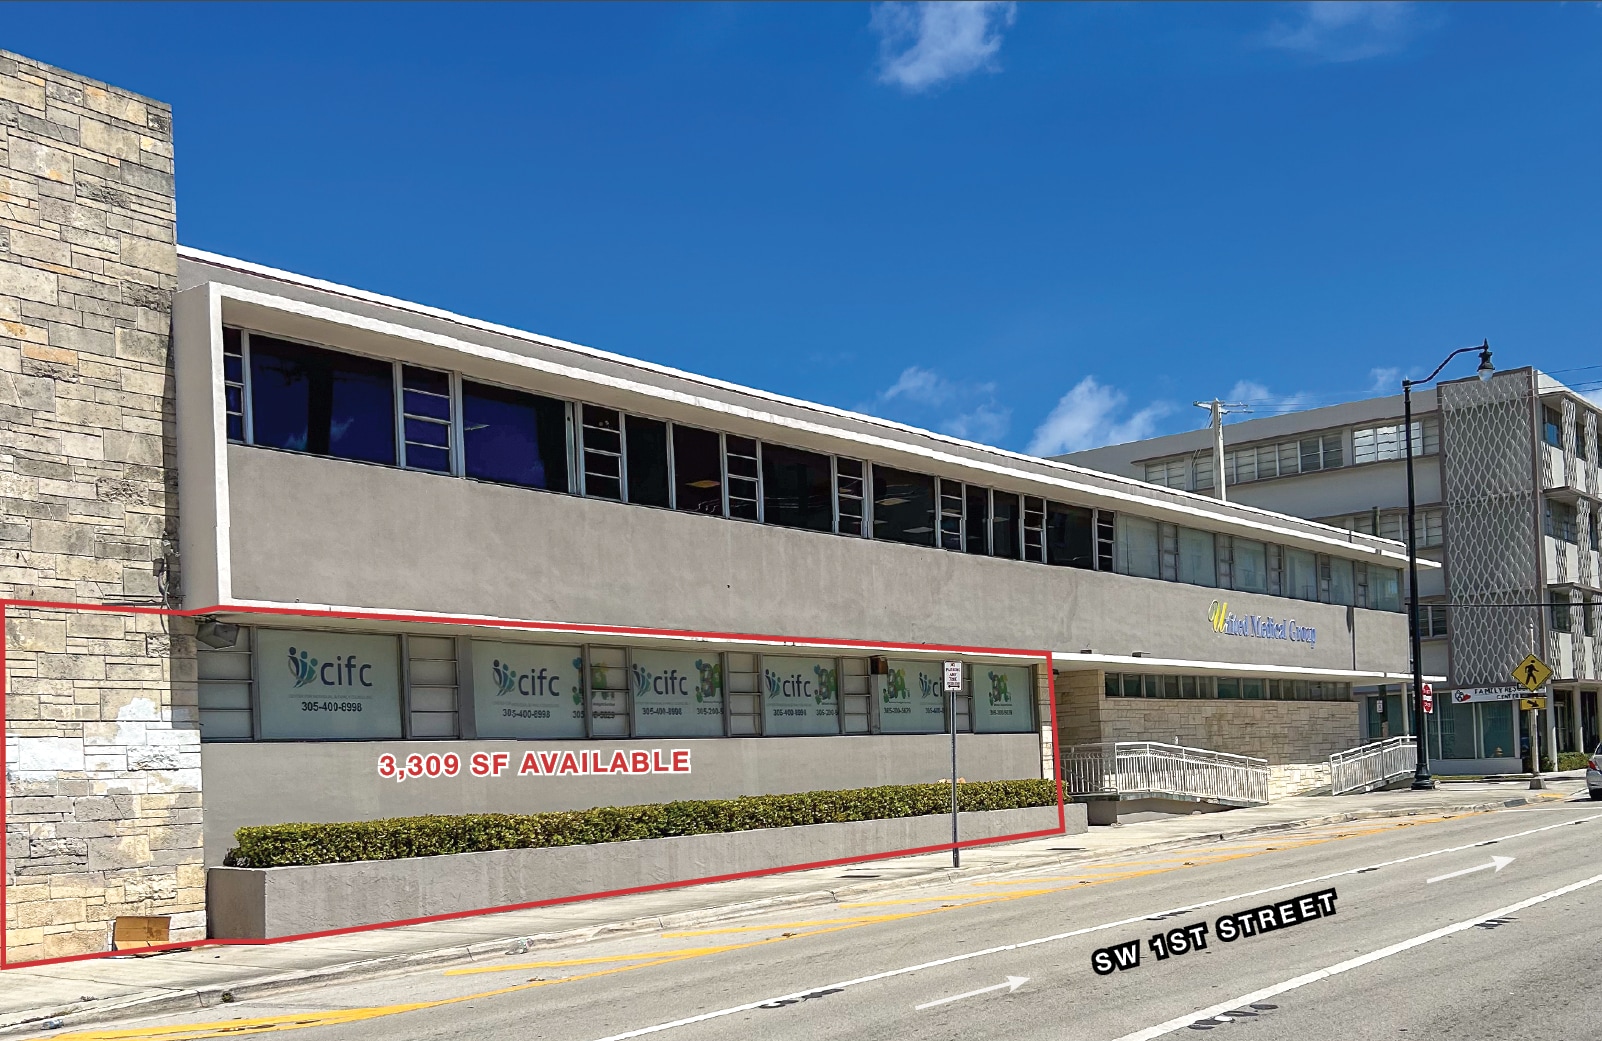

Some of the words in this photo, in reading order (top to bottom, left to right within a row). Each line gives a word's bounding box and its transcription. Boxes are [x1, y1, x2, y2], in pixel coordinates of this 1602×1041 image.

[1207, 599, 1248, 635] United
[1250, 615, 1287, 640] Medical
[1289, 619, 1317, 649] Group
[320, 655, 373, 687] cifc
[518, 668, 560, 697] cifc
[653, 669, 689, 696] cifc
[782, 674, 812, 698] cifc
[1474, 687, 1503, 695] FAMILY
[301, 701, 363, 712] 305-400-8998
